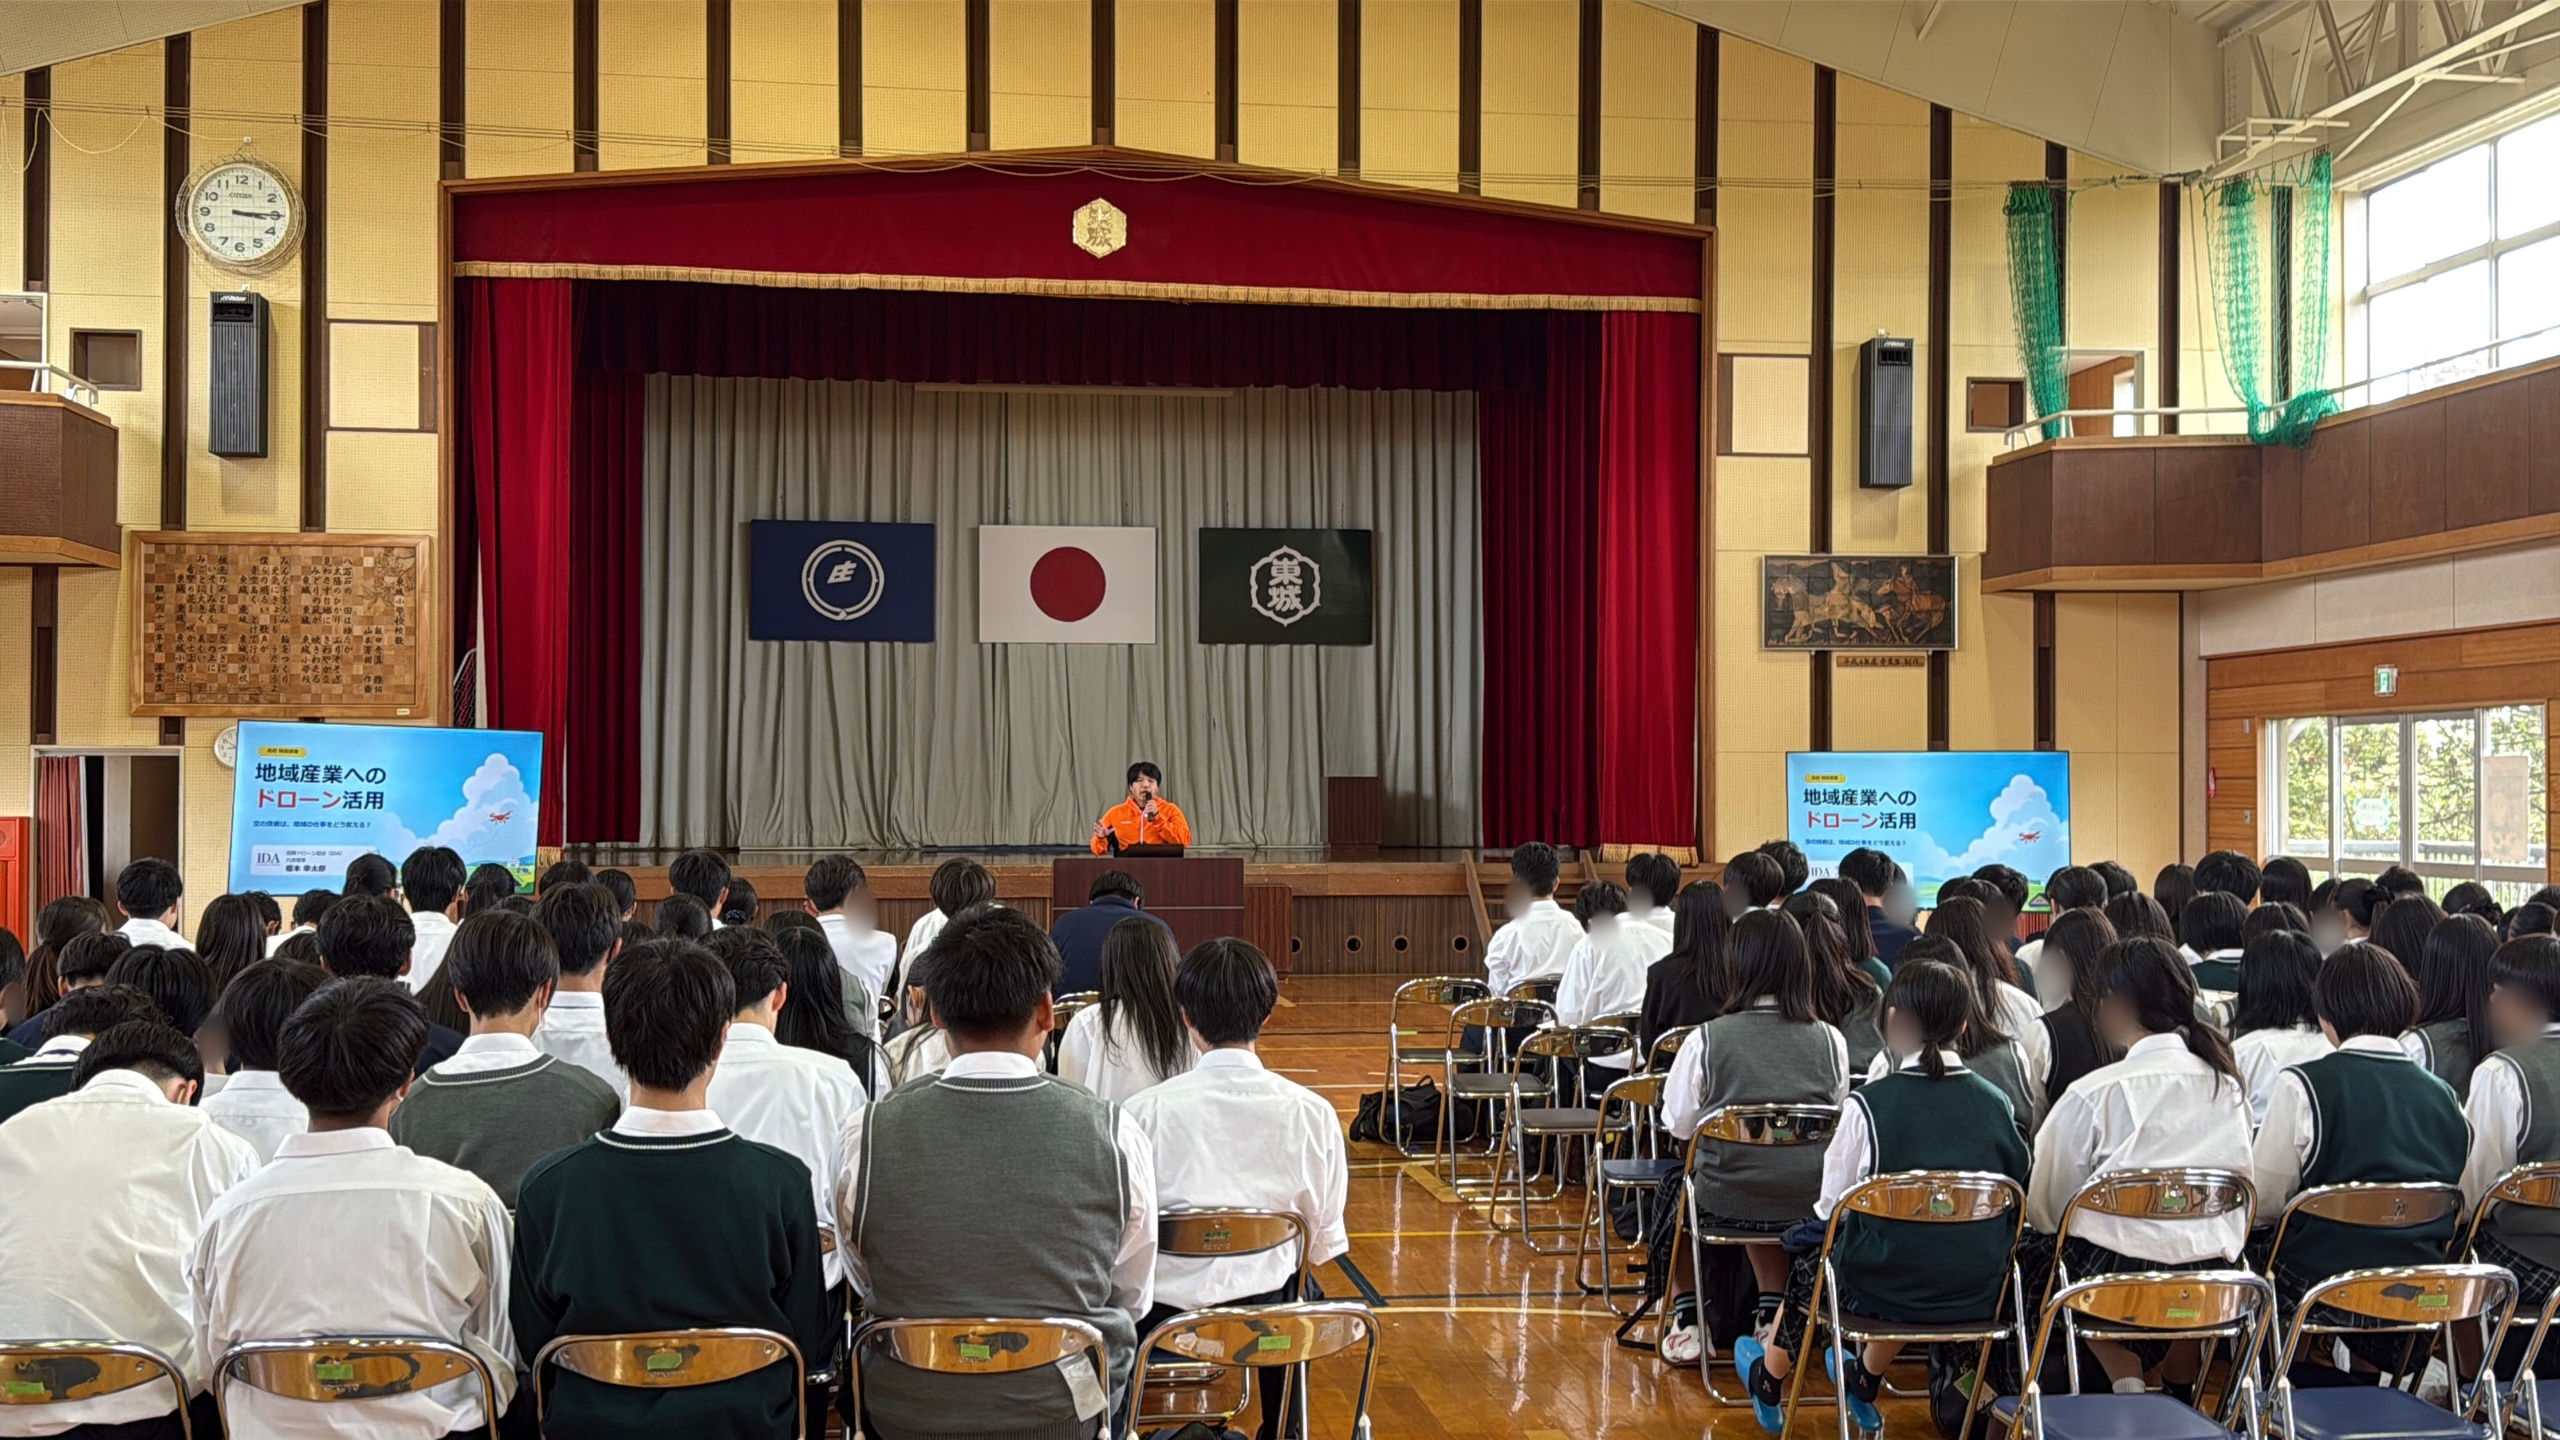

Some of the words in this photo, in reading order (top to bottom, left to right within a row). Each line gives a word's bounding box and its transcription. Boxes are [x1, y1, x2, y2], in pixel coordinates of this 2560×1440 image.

[217, 180, 229, 189] 11
[235, 175, 249, 185] 12
[258, 181, 262, 190] 1
[205, 192, 218, 202] 10
[267, 193, 277, 203] 2
[200, 206, 211, 216] 9
[270, 210, 280, 221] 3
[204, 222, 215, 232] 8
[265, 227, 276, 236] 4
[218, 237, 229, 246] 7
[253, 239, 263, 249] 5
[234, 243, 245, 252] 6
[1267, 557, 1304, 612] 東城
[254, 763, 387, 785] 地域産業への
[258, 788, 385, 810] ドローン活用
[1803, 788, 1918, 806] 地域産業への
[1807, 811, 1917, 829] ドローン活用
[256, 852, 281, 864] IDA
[1811, 866, 1831, 877] IDA
